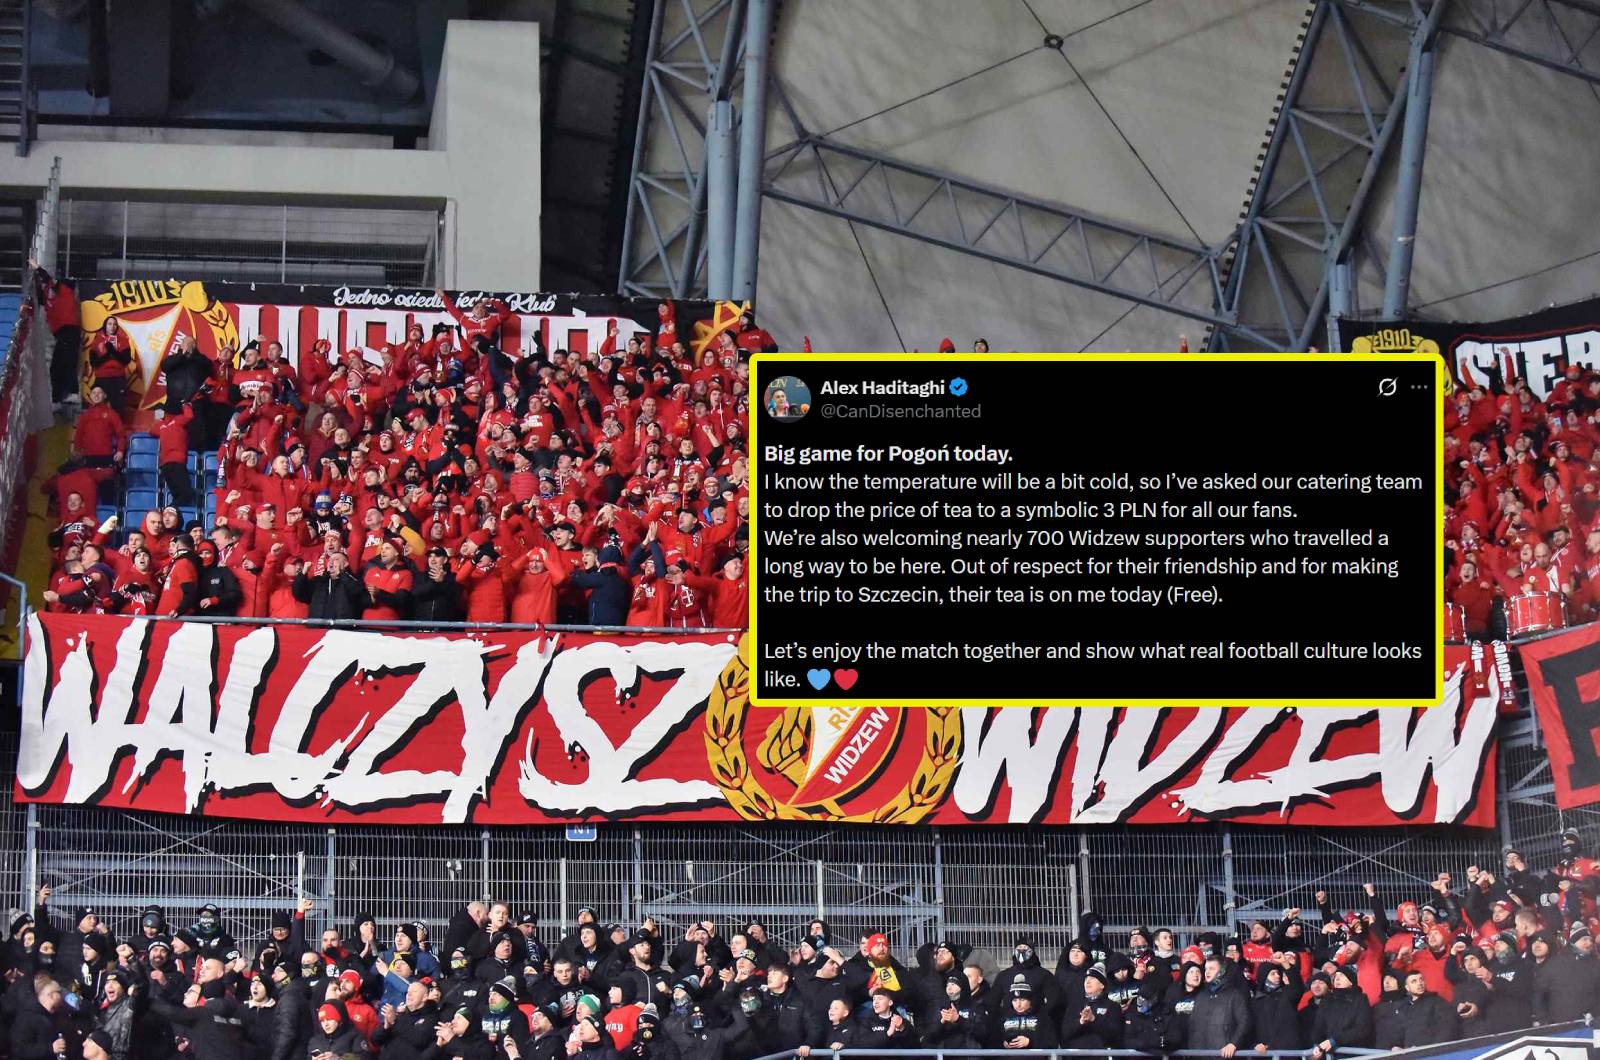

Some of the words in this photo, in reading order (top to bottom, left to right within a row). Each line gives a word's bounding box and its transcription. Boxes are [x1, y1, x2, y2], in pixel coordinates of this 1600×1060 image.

[111, 280, 168, 310] 1910
[333, 286, 393, 306] Jedno
[1378, 328, 1411, 349] 1910
[16, 612, 739, 824] WALCZYSZ
[823, 707, 891, 785] WIDZEW
